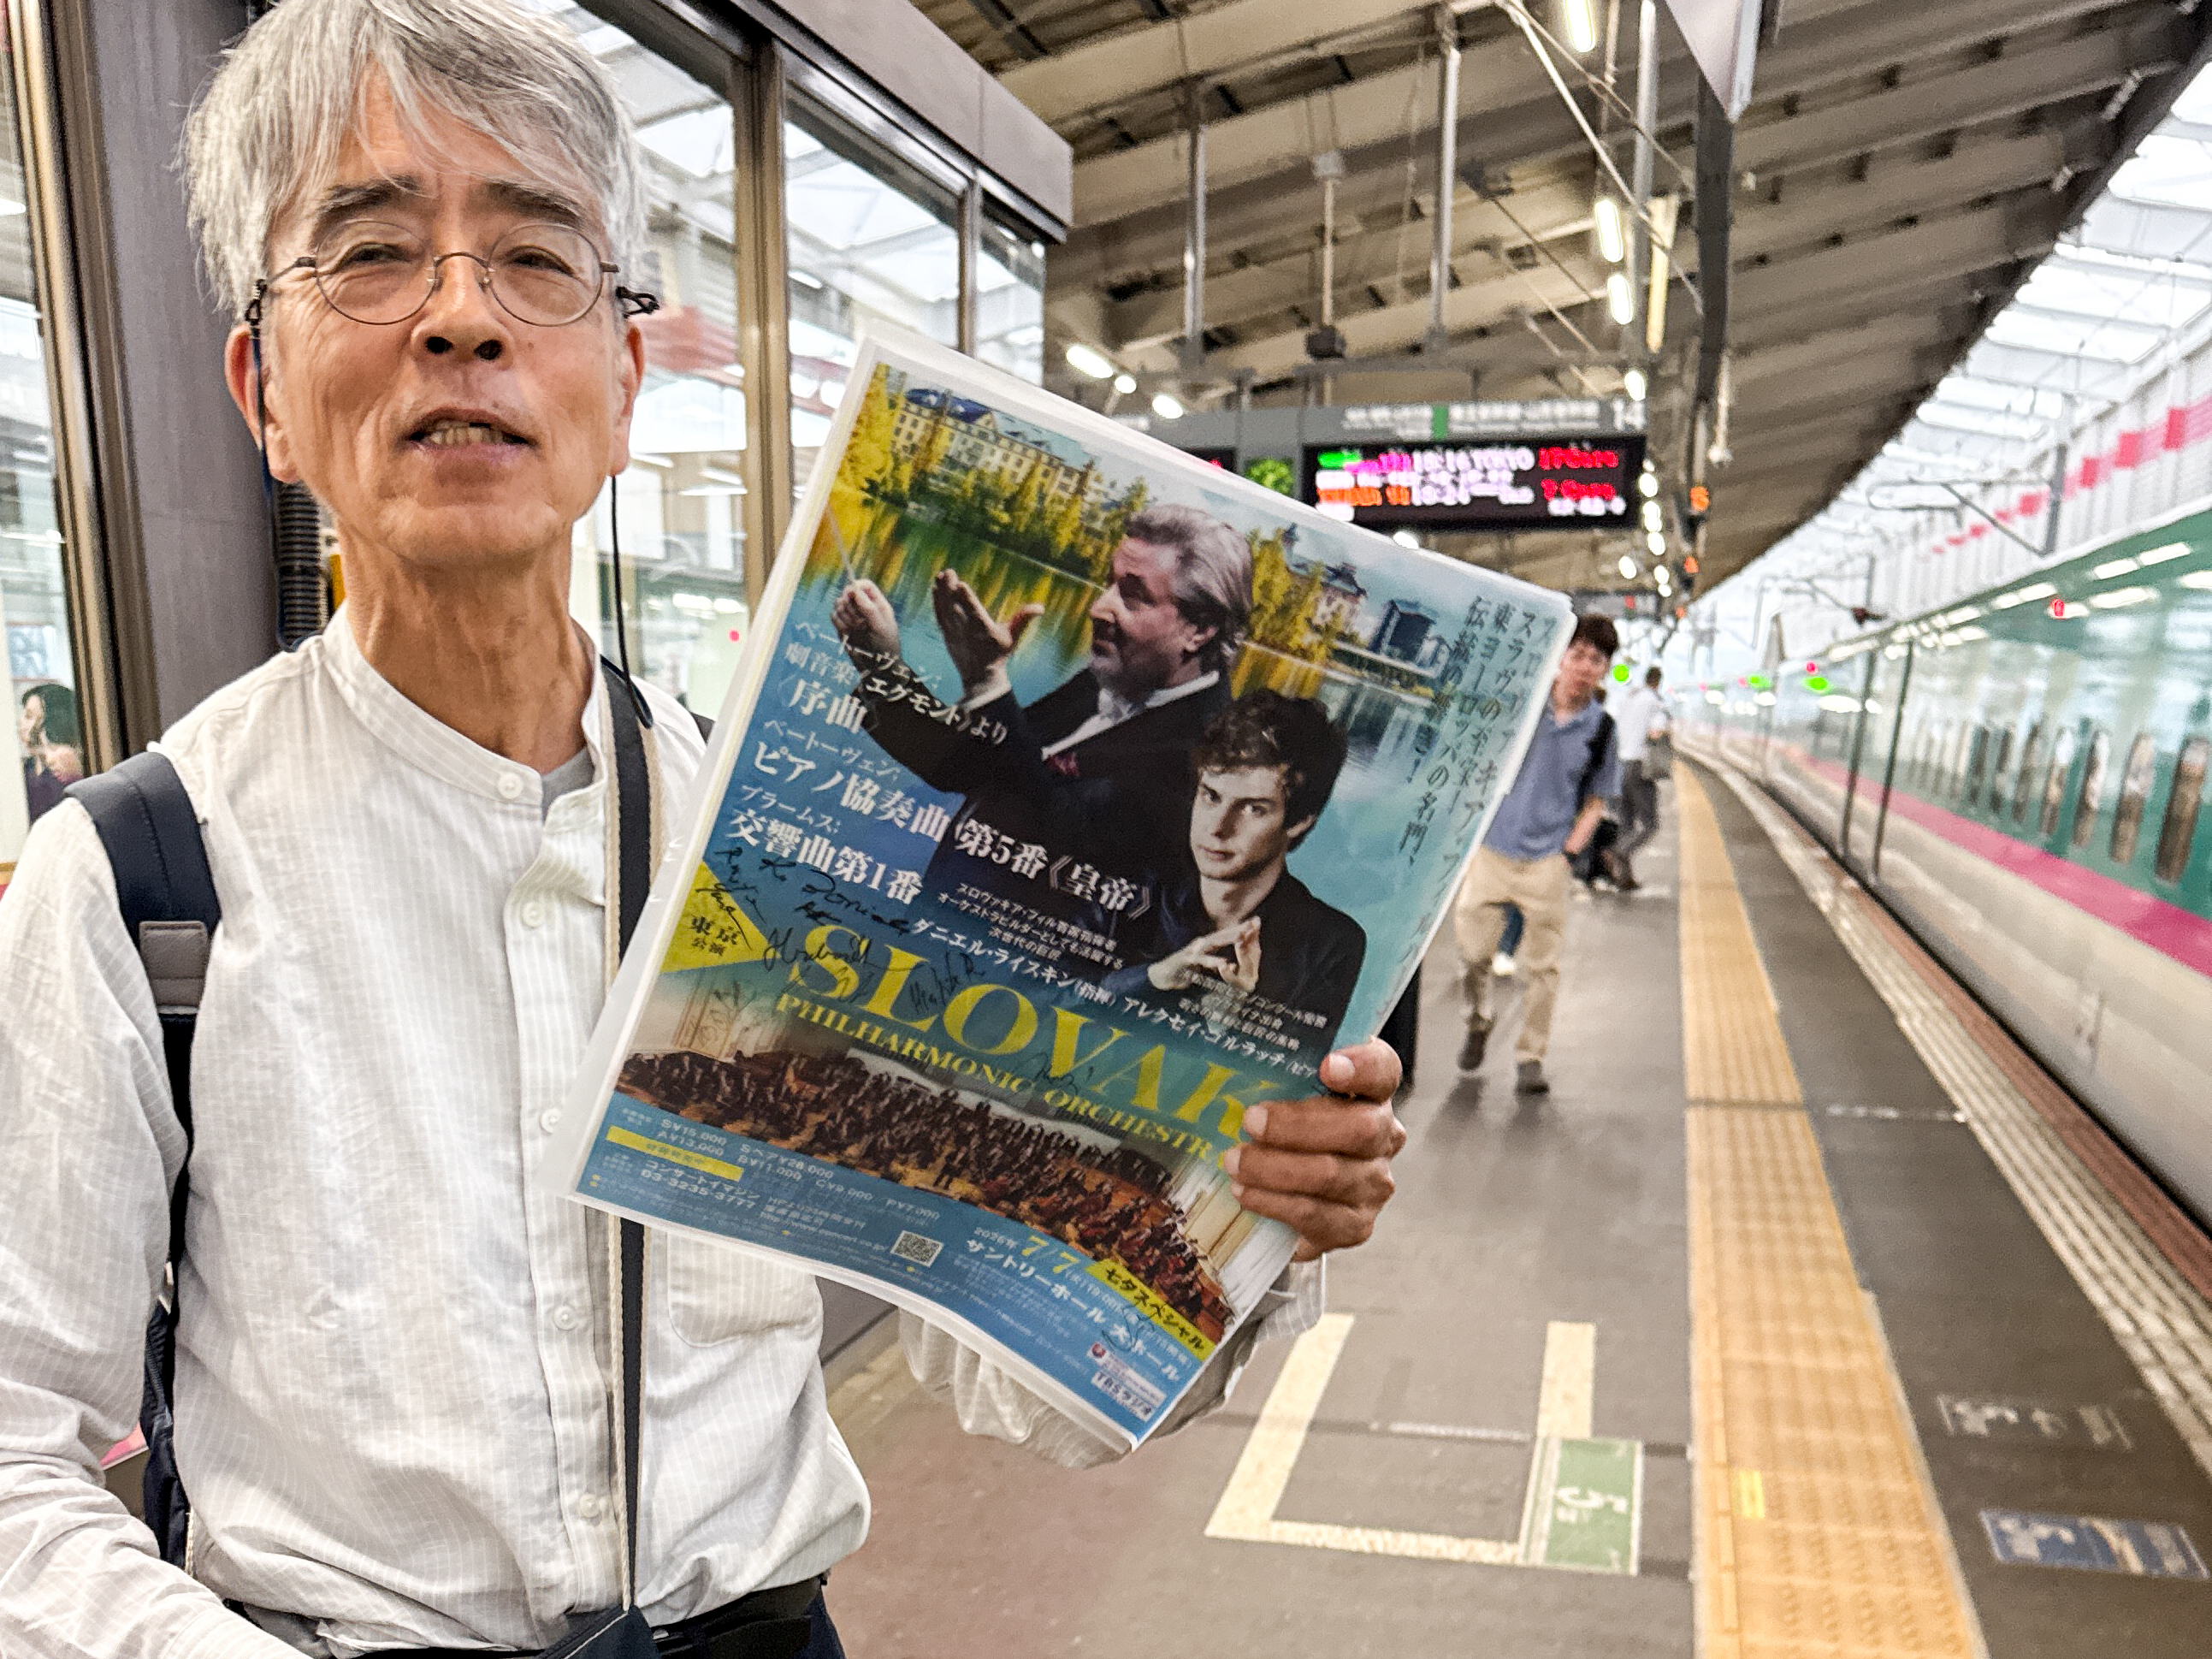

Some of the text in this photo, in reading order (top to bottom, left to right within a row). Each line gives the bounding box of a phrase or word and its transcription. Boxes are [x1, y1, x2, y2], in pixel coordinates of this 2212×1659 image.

[725, 803, 926, 908] 交響曲第1番
[688, 911, 742, 949] 東京
[775, 990, 1032, 1097] PHILHARMONIC
[1041, 1084, 1233, 1169] ORCHESTR
[789, 924, 1282, 1135] SLOVAK
[967, 1241, 1107, 1324] サントリーホール
